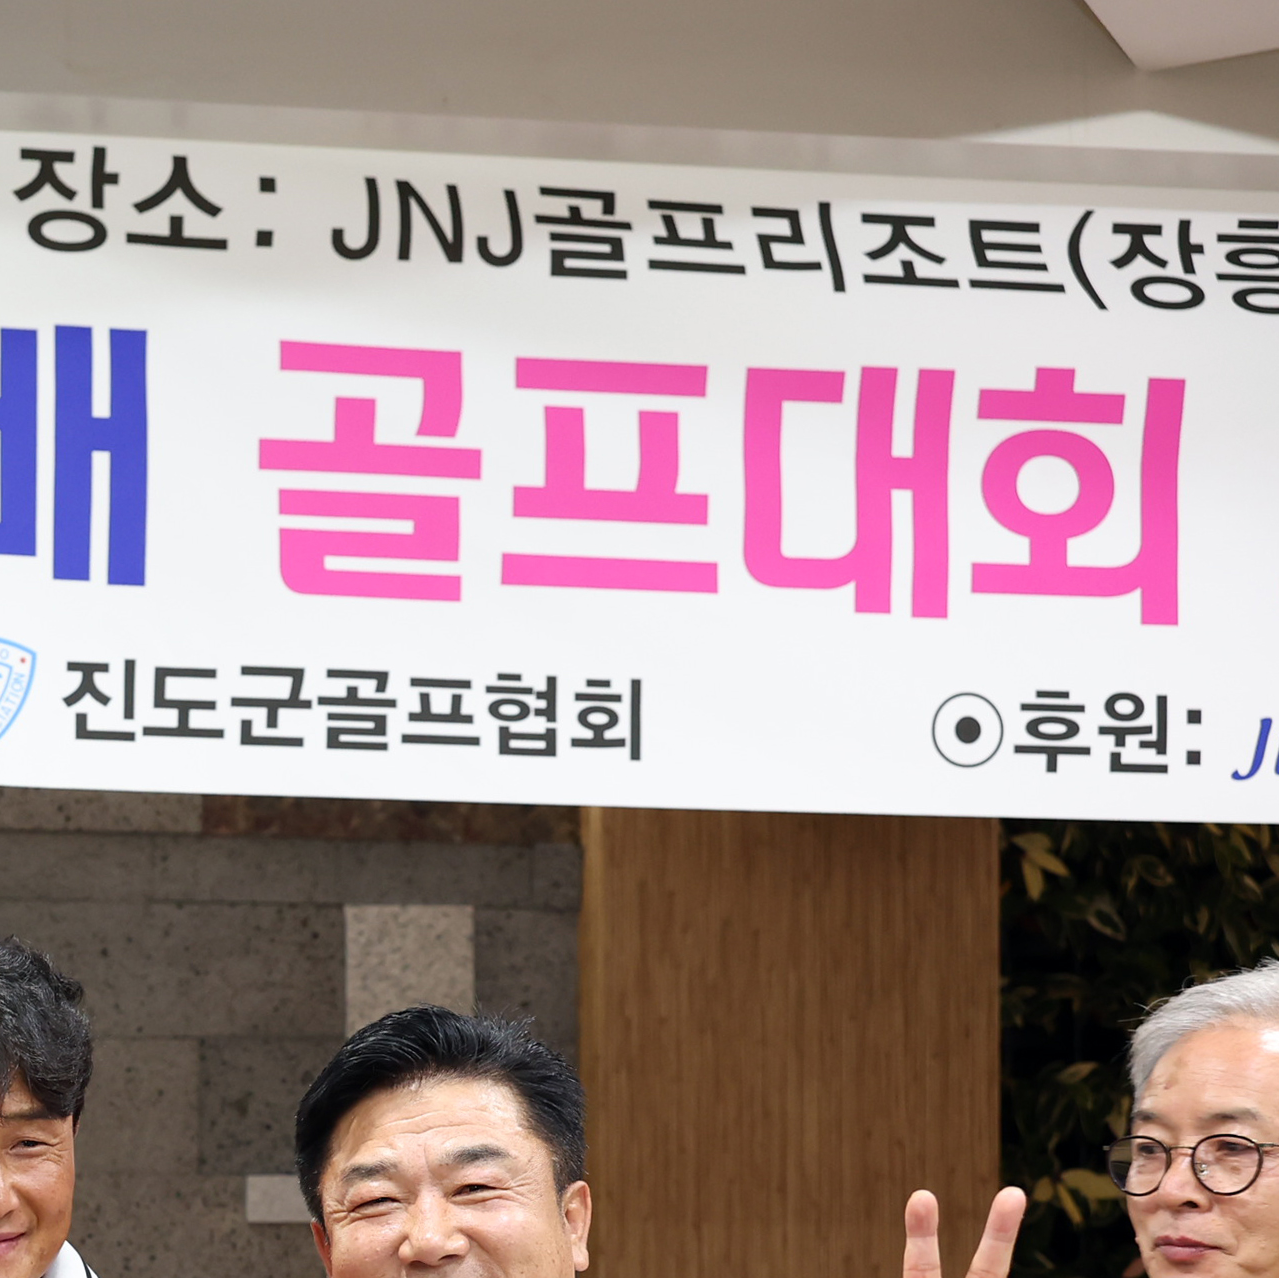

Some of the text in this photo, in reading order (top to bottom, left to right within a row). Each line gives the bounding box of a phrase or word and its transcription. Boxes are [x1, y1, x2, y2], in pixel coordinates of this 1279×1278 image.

[14, 147, 275, 251] 장소:
[259, 340, 1186, 626] 골프대회
[64, 660, 640, 760] 진도군골프협회
[1015, 691, 1201, 773] 후원:
